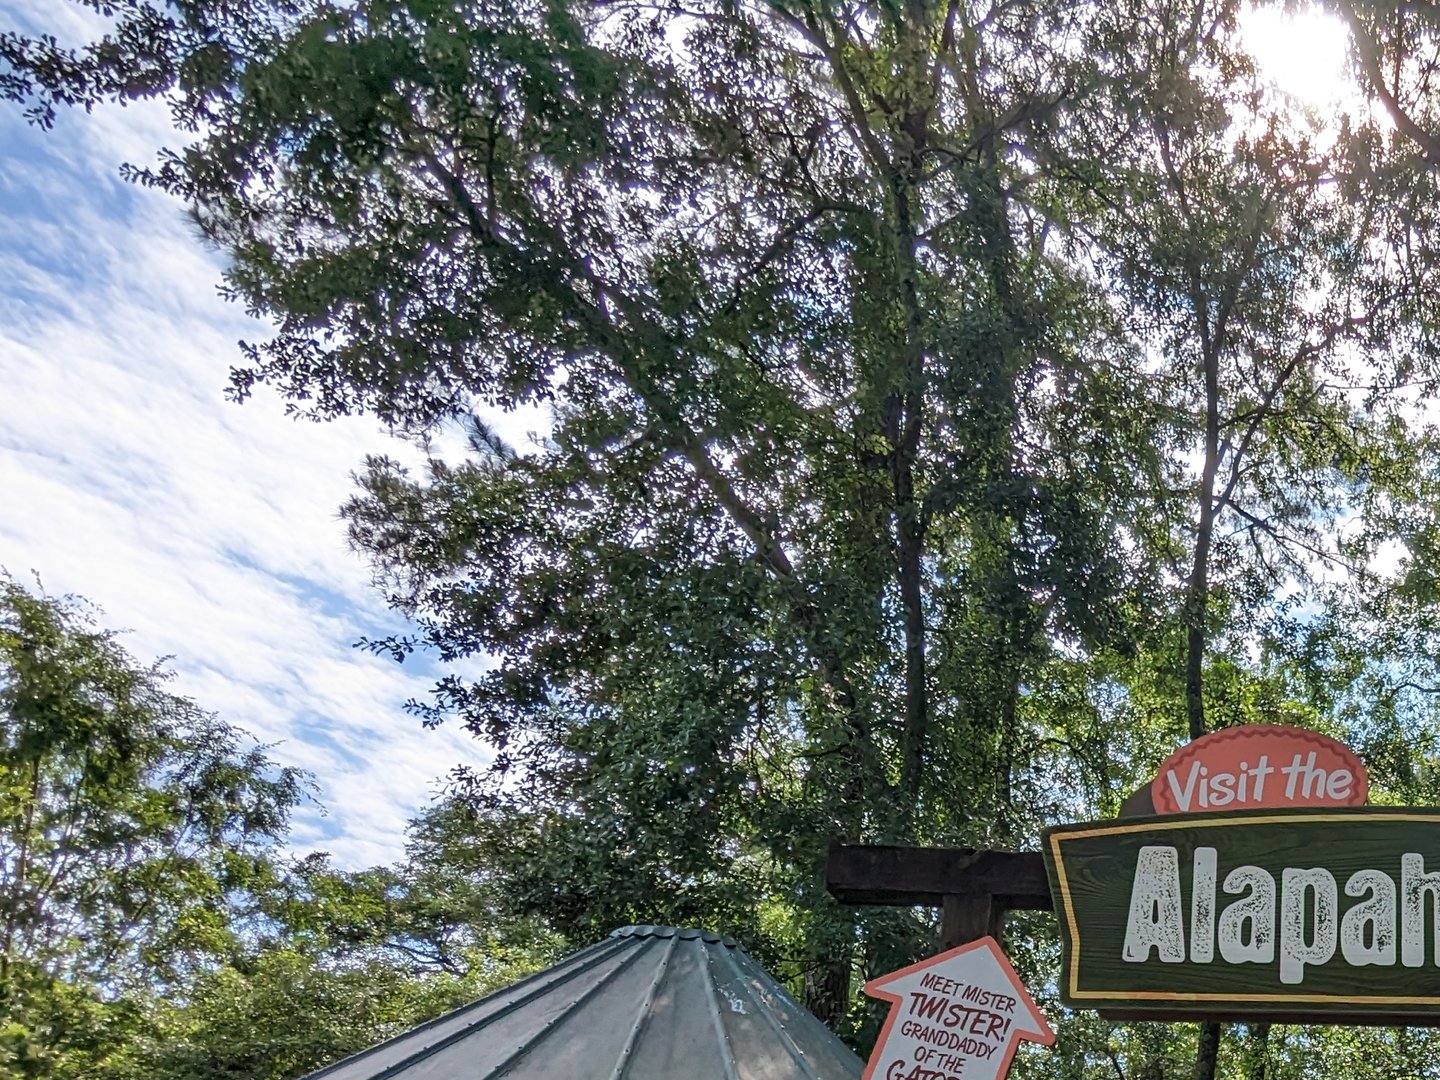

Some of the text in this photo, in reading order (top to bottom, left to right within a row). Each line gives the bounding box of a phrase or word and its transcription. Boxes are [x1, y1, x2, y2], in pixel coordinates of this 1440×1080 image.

[1166, 751, 1354, 812] Visit the
[920, 972, 1017, 1014] MEET MISTER
[909, 992, 1012, 1043] TWISTER!
[901, 1020, 998, 1060] GRANDDADDY
[914, 1046, 966, 1074] OF THE
